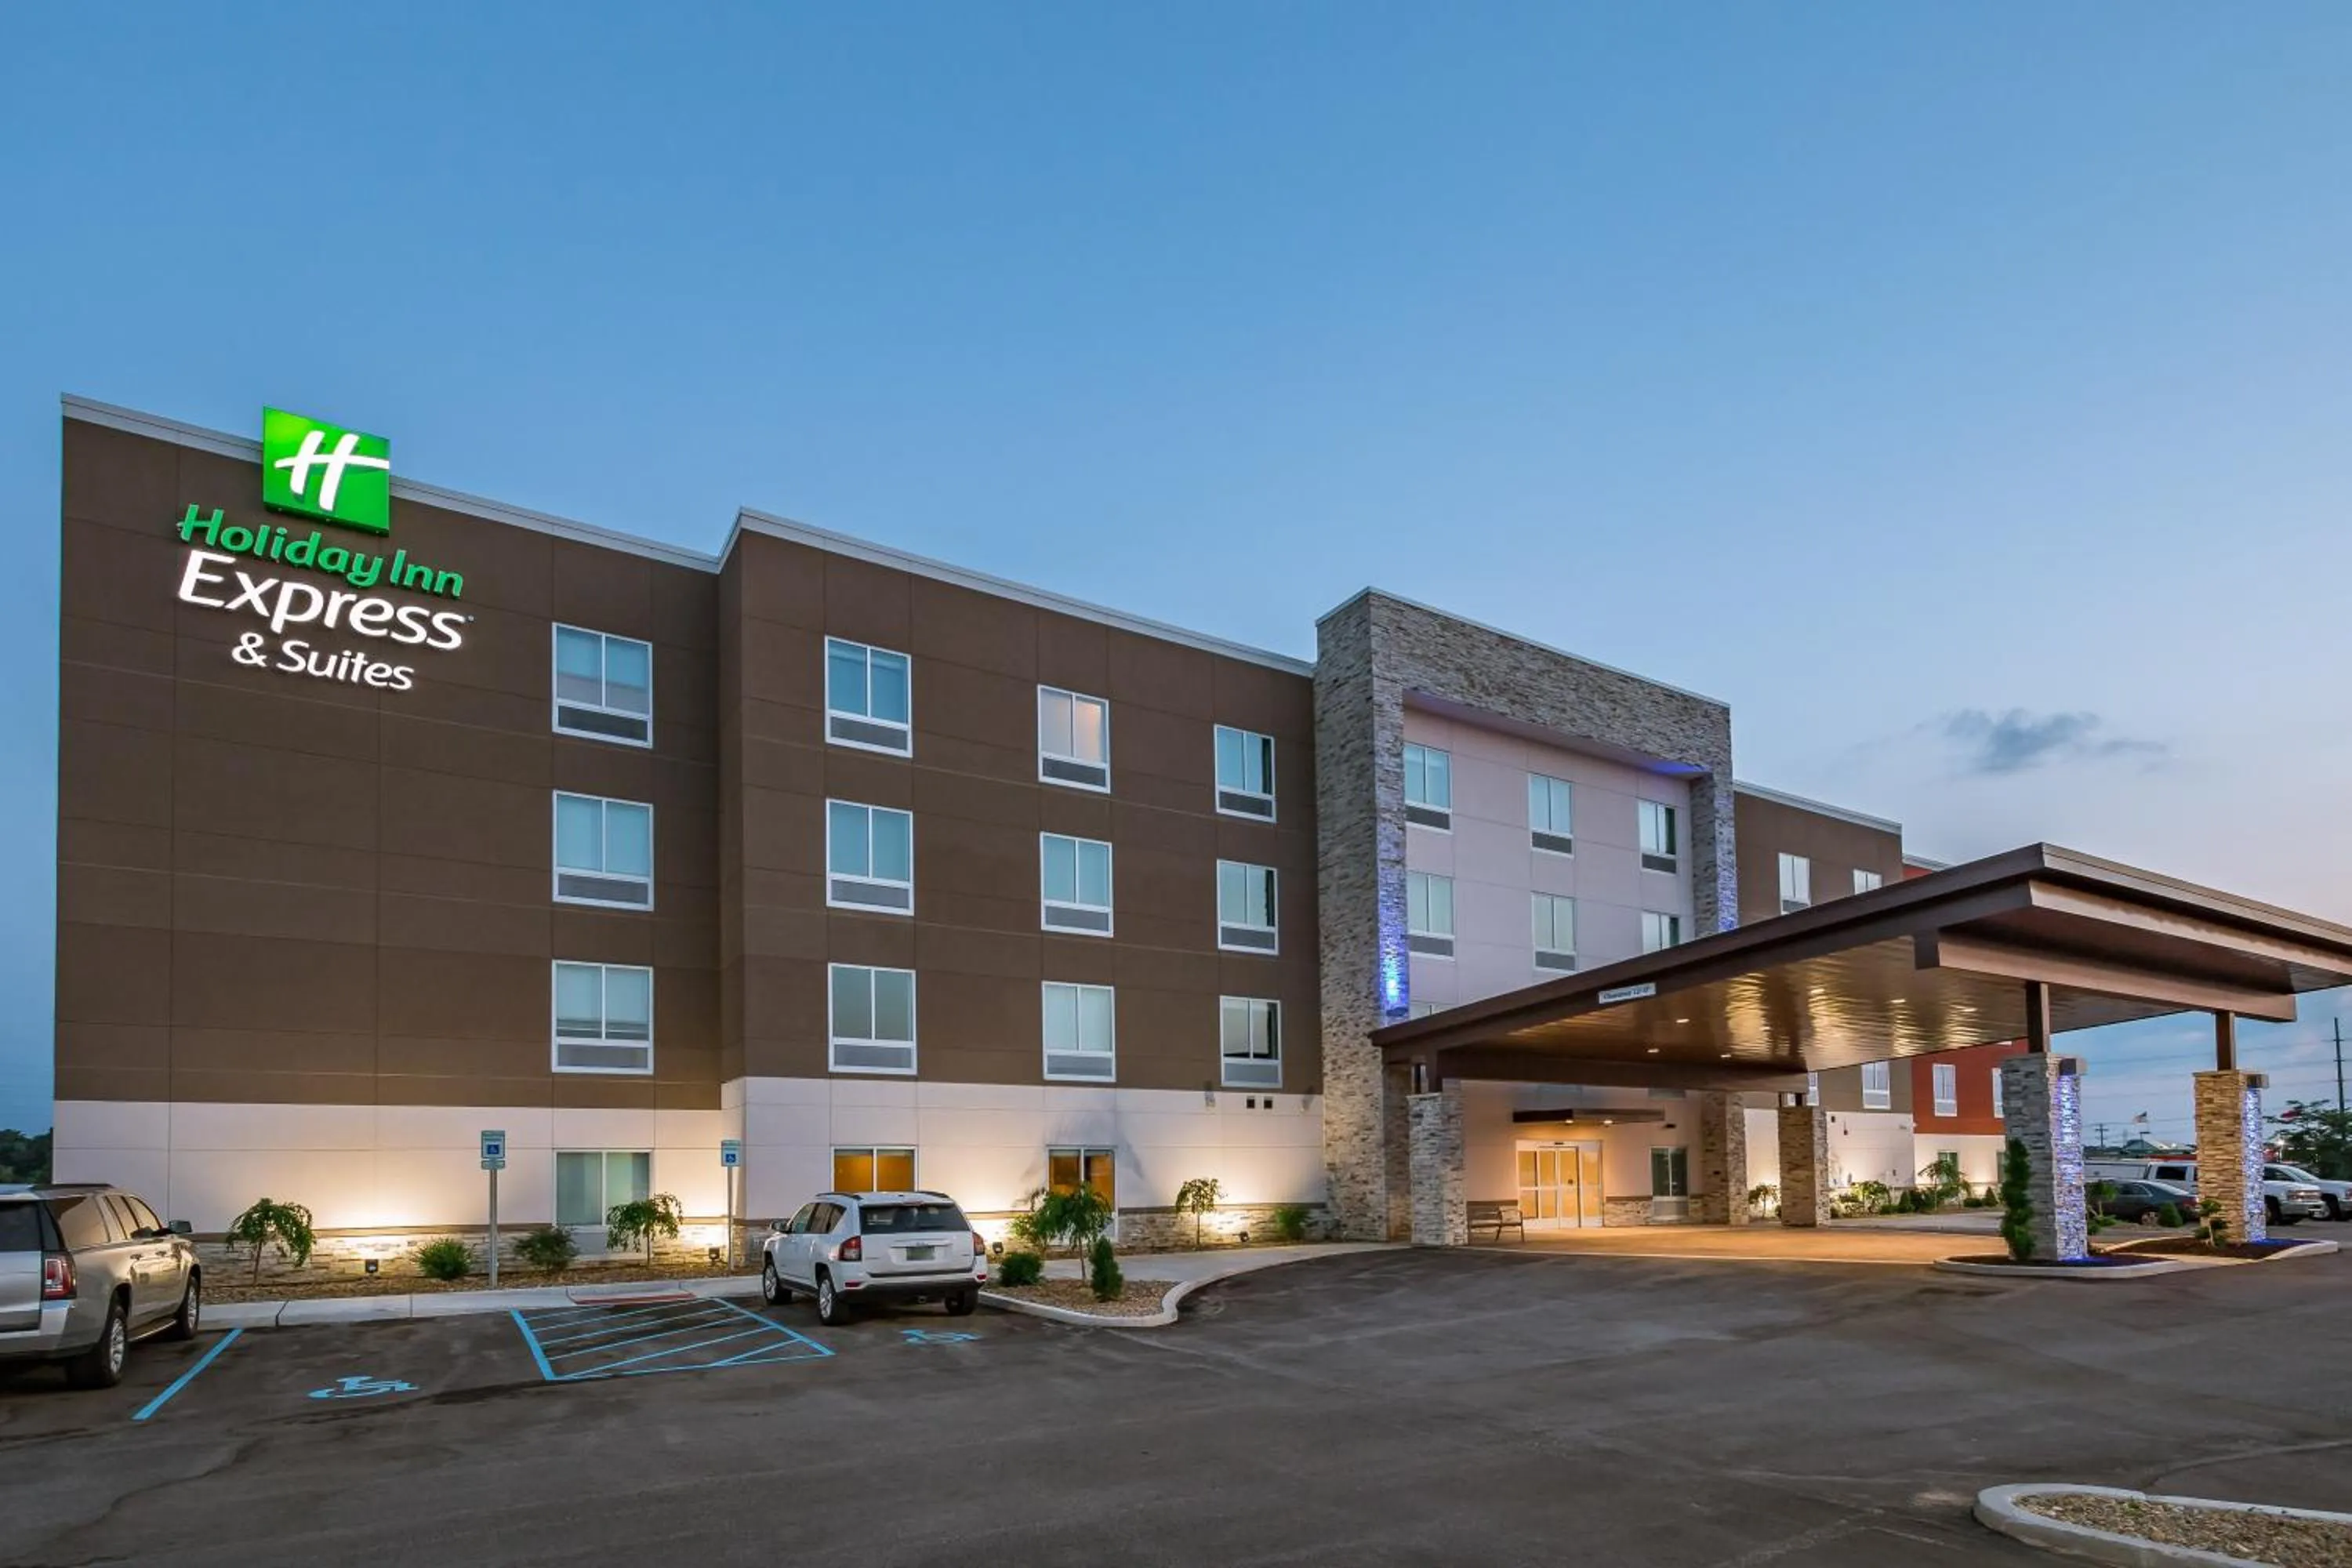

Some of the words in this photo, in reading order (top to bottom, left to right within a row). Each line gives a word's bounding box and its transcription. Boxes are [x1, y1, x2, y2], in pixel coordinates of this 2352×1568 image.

[274, 430, 390, 511] H
[177, 503, 383, 587] Holiday
[390, 549, 464, 597] Inn
[178, 550, 466, 650] Express
[231, 632, 267, 667] &
[277, 640, 415, 690] Suites
